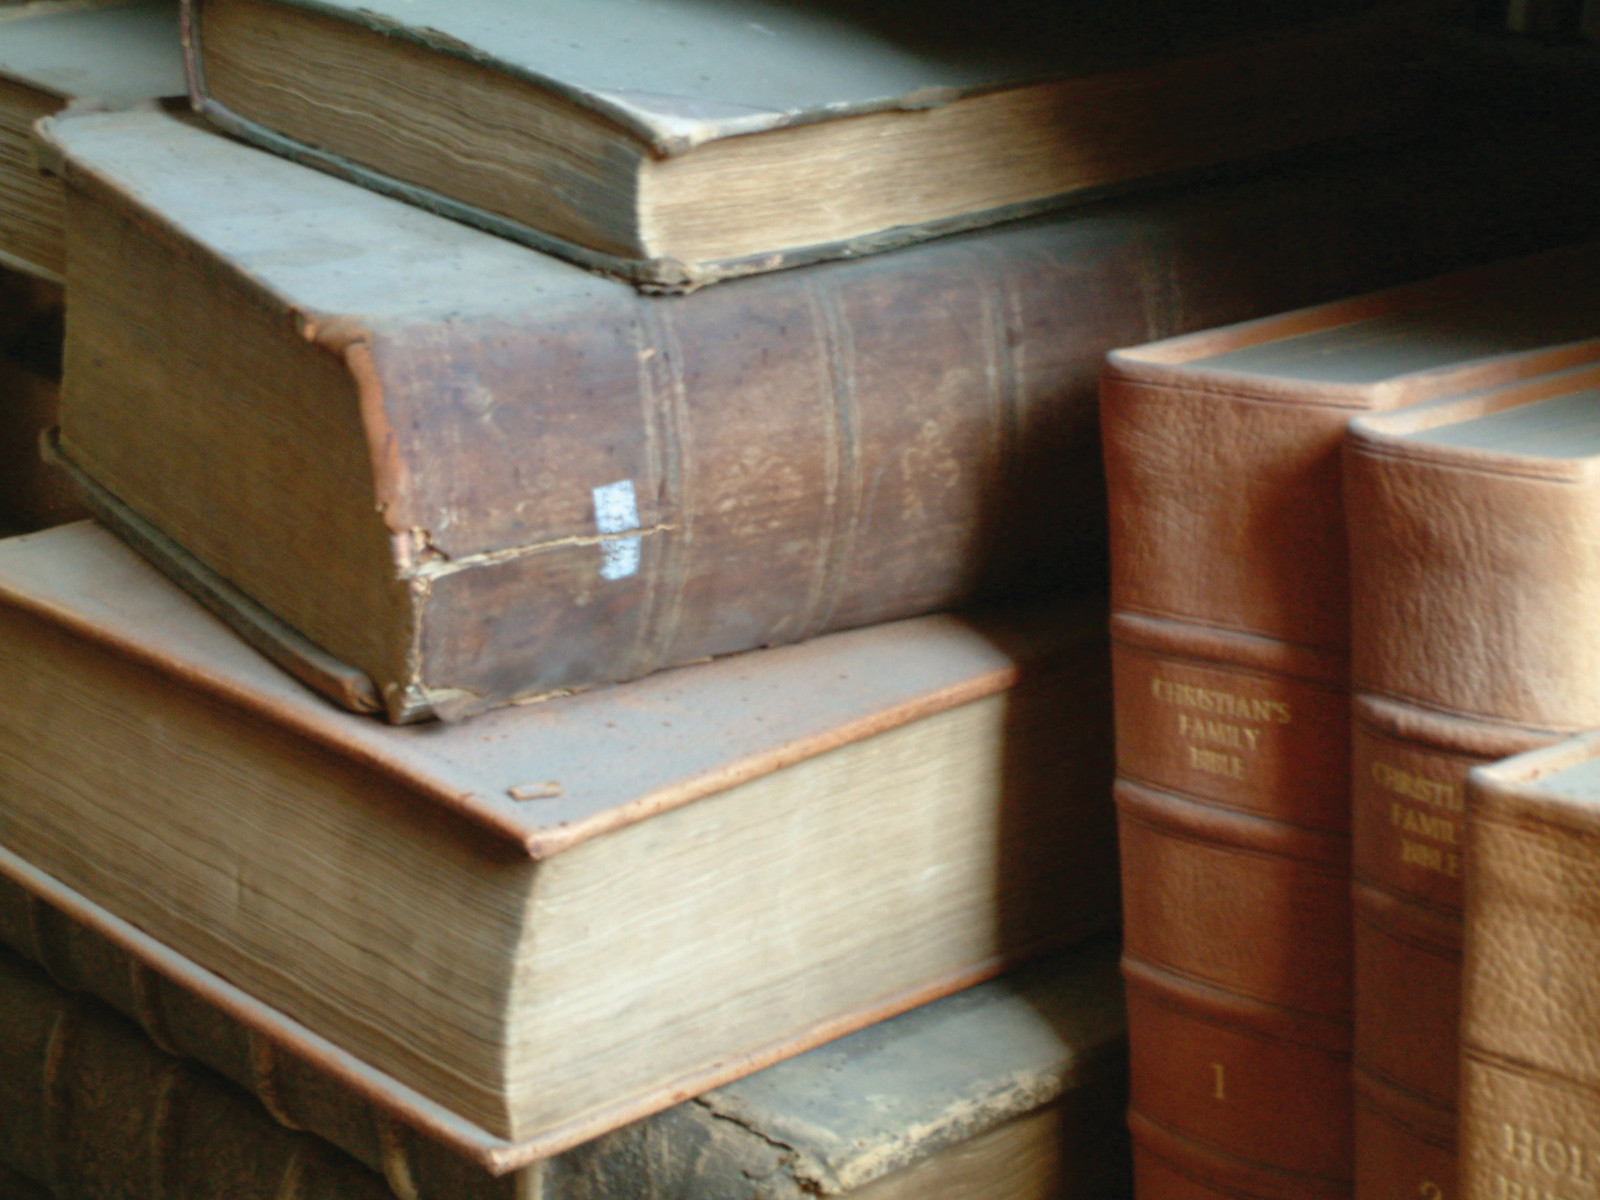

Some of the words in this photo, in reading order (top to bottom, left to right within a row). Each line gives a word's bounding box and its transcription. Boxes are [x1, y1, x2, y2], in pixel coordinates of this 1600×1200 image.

[1152, 678, 1291, 724] CHRISTIAN'S
[1178, 713, 1260, 751] FAMILY
[1190, 745, 1246, 780] BIBLE
[1371, 761, 1463, 812] CHRISTI
[1391, 802, 1464, 845] FAMIL
[1211, 1062, 1225, 1100] 1
[1503, 1122, 1600, 1190] HOL
